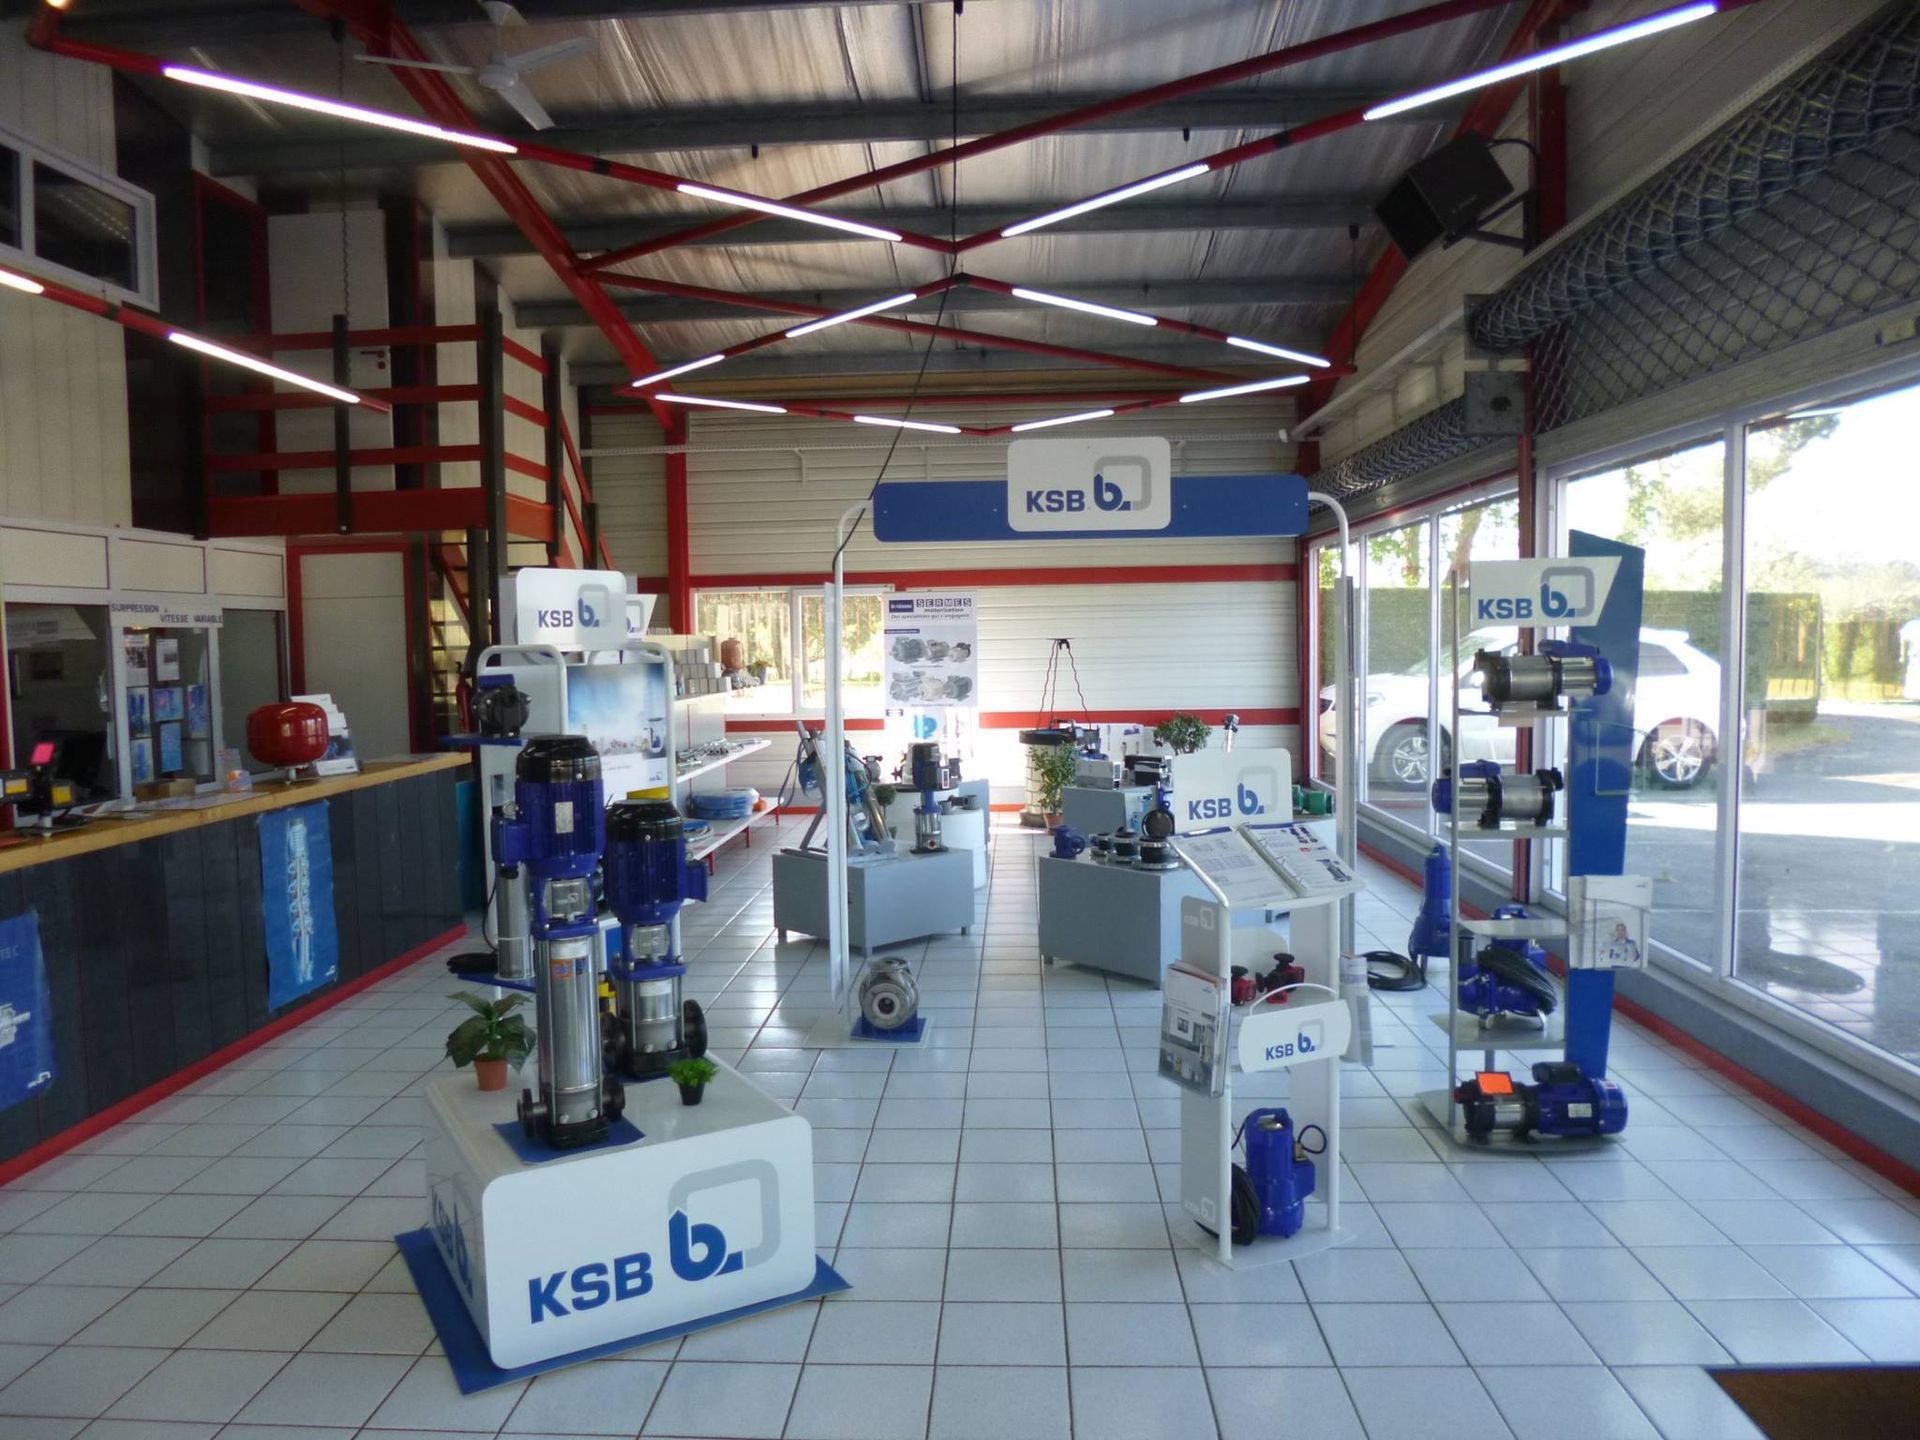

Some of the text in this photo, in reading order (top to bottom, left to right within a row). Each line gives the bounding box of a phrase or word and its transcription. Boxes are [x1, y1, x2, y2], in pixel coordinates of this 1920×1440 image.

[1026, 490, 1085, 512] KSB
[111, 603, 160, 613] SURPRESSION
[916, 598, 972, 608] SERMES
[1478, 598, 1533, 619] KSB
[160, 614, 188, 624] VITESSE
[538, 610, 574, 628] KSB
[1188, 798, 1232, 821] KSB
[1265, 1042, 1294, 1061] KSB
[528, 1251, 654, 1325] KSB
